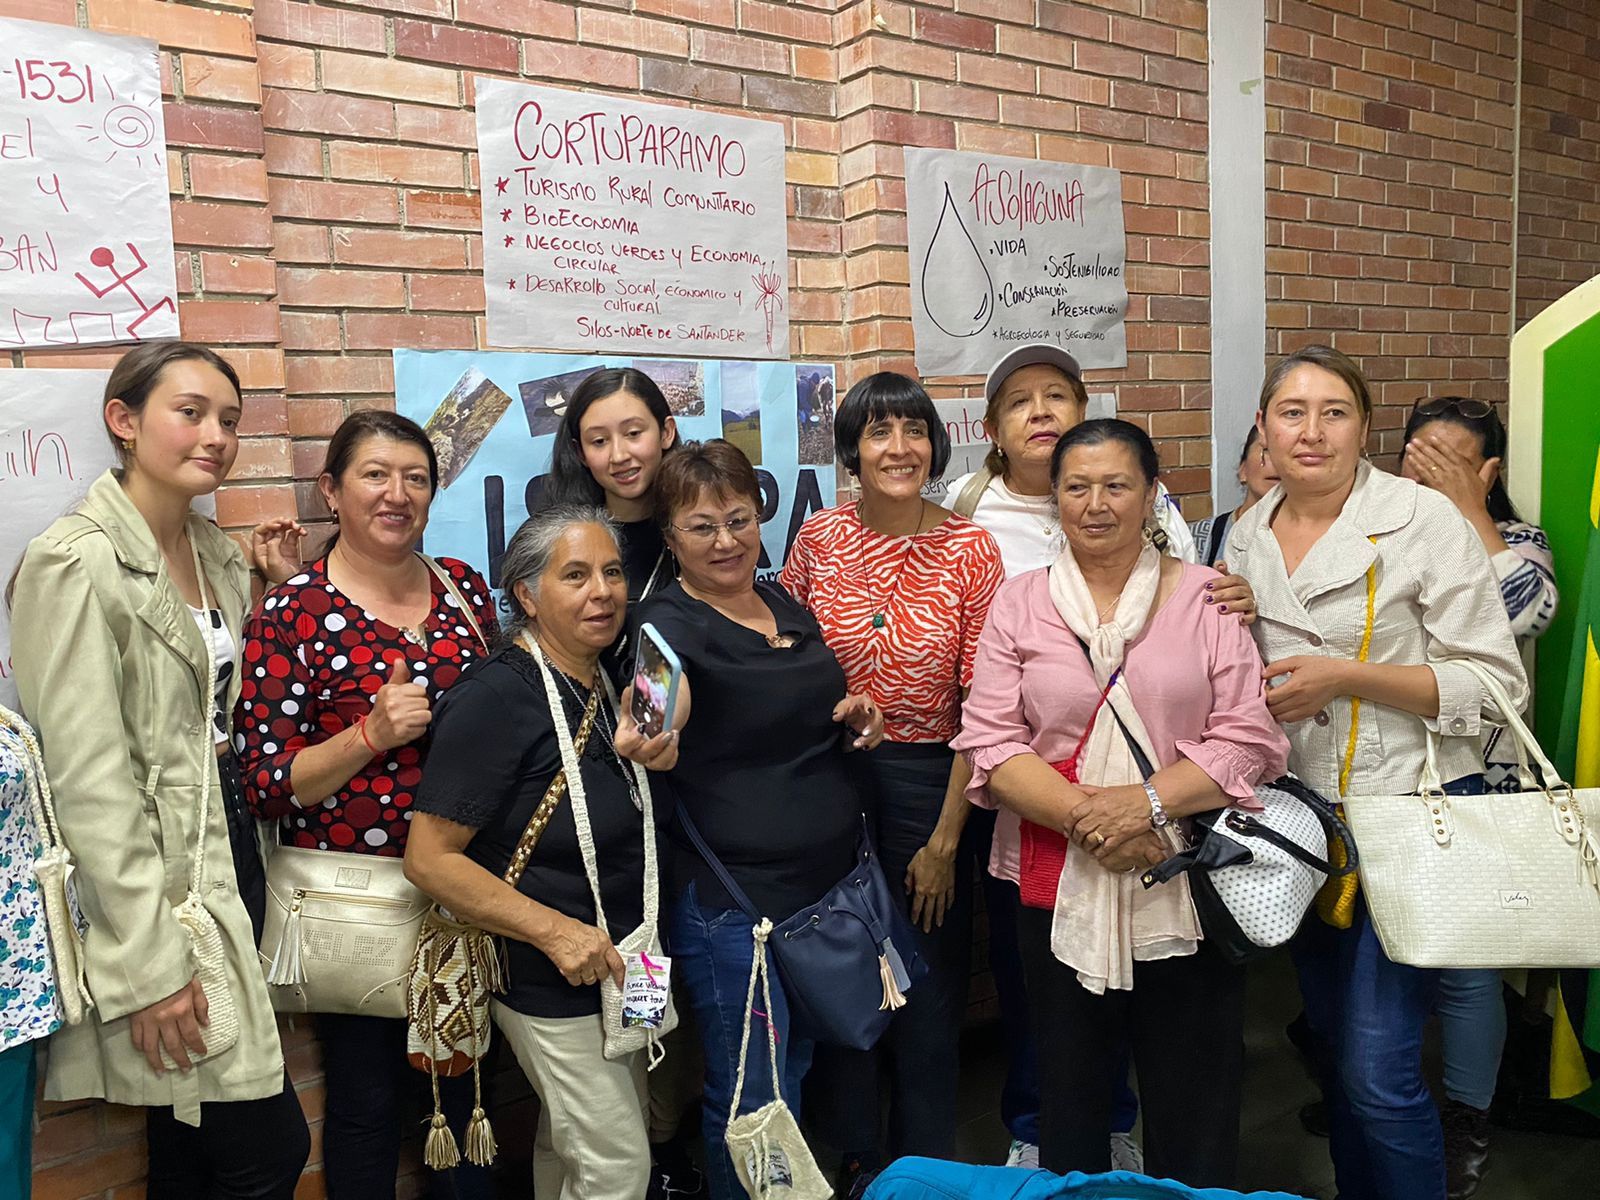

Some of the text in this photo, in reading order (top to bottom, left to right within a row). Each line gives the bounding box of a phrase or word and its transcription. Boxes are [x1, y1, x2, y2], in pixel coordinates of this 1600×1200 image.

[514, 101, 746, 178] CORTUPARAMO
[514, 167, 597, 201] TURISMO
[609, 175, 652, 208] RURAL
[526, 234, 604, 256] NEGOCIOS
[611, 241, 665, 261] VERDES
[993, 237, 1027, 257] VIDA
[554, 256, 620, 275] CIRCULAR
[1048, 253, 1120, 280] SOSTENIBILIDAD
[525, 273, 606, 296] DESARROLLO
